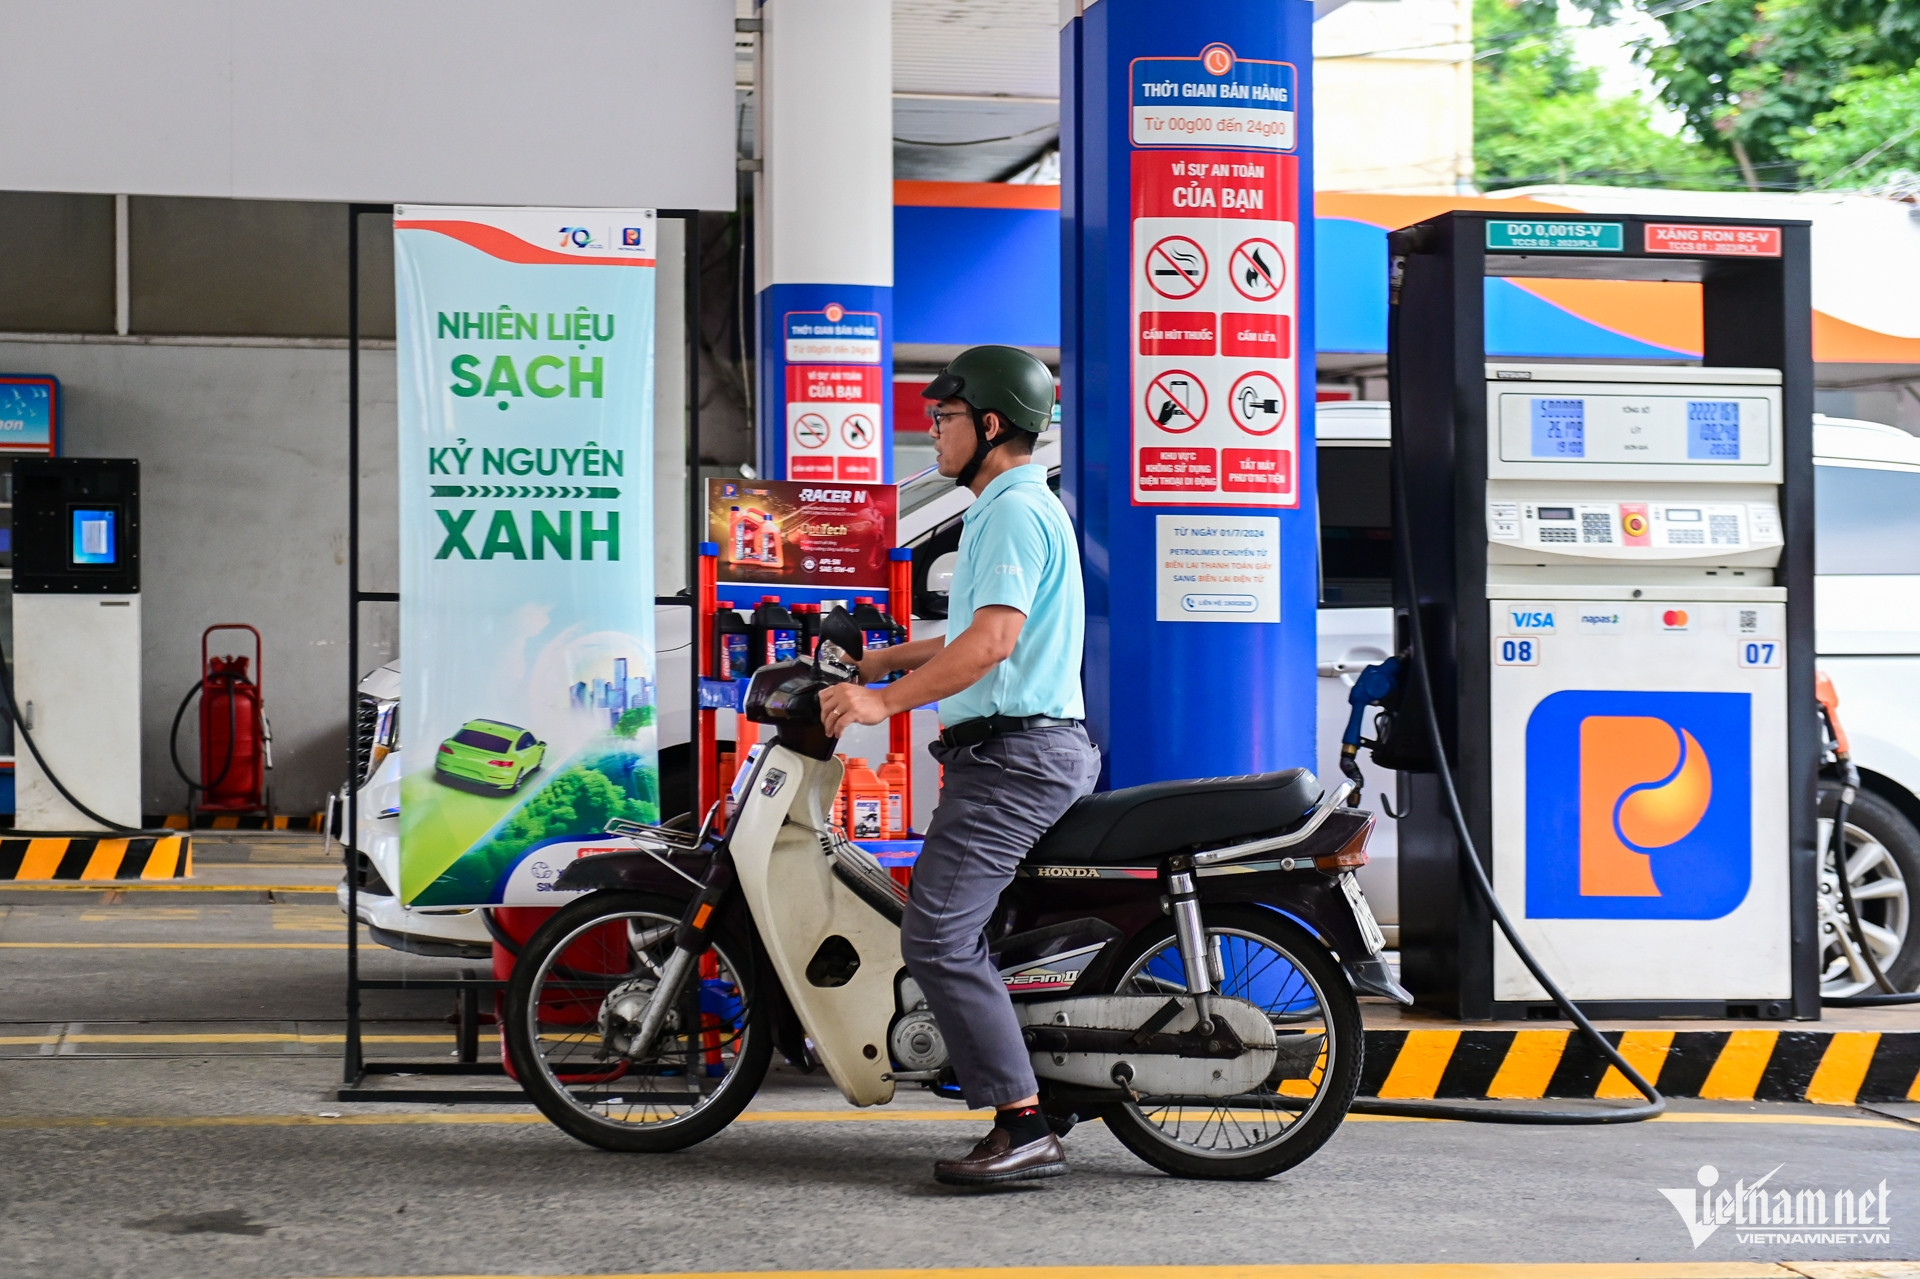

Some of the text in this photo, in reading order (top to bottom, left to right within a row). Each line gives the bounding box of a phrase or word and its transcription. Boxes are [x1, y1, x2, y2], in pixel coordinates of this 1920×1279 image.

[1142, 80, 1288, 102] THỜI GIAN BÁN HÀNG
[1144, 117, 1286, 137] Từ 00g00 đến 24g00
[1171, 161, 1265, 178] VÌ SỰ AN TOÀN
[1172, 180, 1264, 213] CỦA BẠN
[1507, 224, 1602, 238] DO 0,001S-V
[1657, 227, 1769, 243] XĂNG RON 95-V
[1511, 239, 1537, 247] TCCS
[438, 305, 615, 350] NHIÊN LIỆU
[450, 354, 604, 411] SẠCH
[808, 381, 862, 400] CỦA BẠN
[429, 438, 624, 477] KỶ NGUYÊN
[799, 488, 868, 504] RACER N
[434, 509, 620, 562] XANH
[1174, 526, 1265, 538] TỪ NGÀY 01/7/2024
[1169, 548, 1221, 556] PETROLIMEX
[1200, 561, 1230, 569] THANH
[1510, 612, 1555, 628] VISA
[1581, 615, 1611, 625] napas
[1503, 641, 1532, 662] 08
[1745, 643, 1775, 664] 07
[1038, 867, 1101, 878] HONDA
[1001, 974, 1062, 985] REAM
